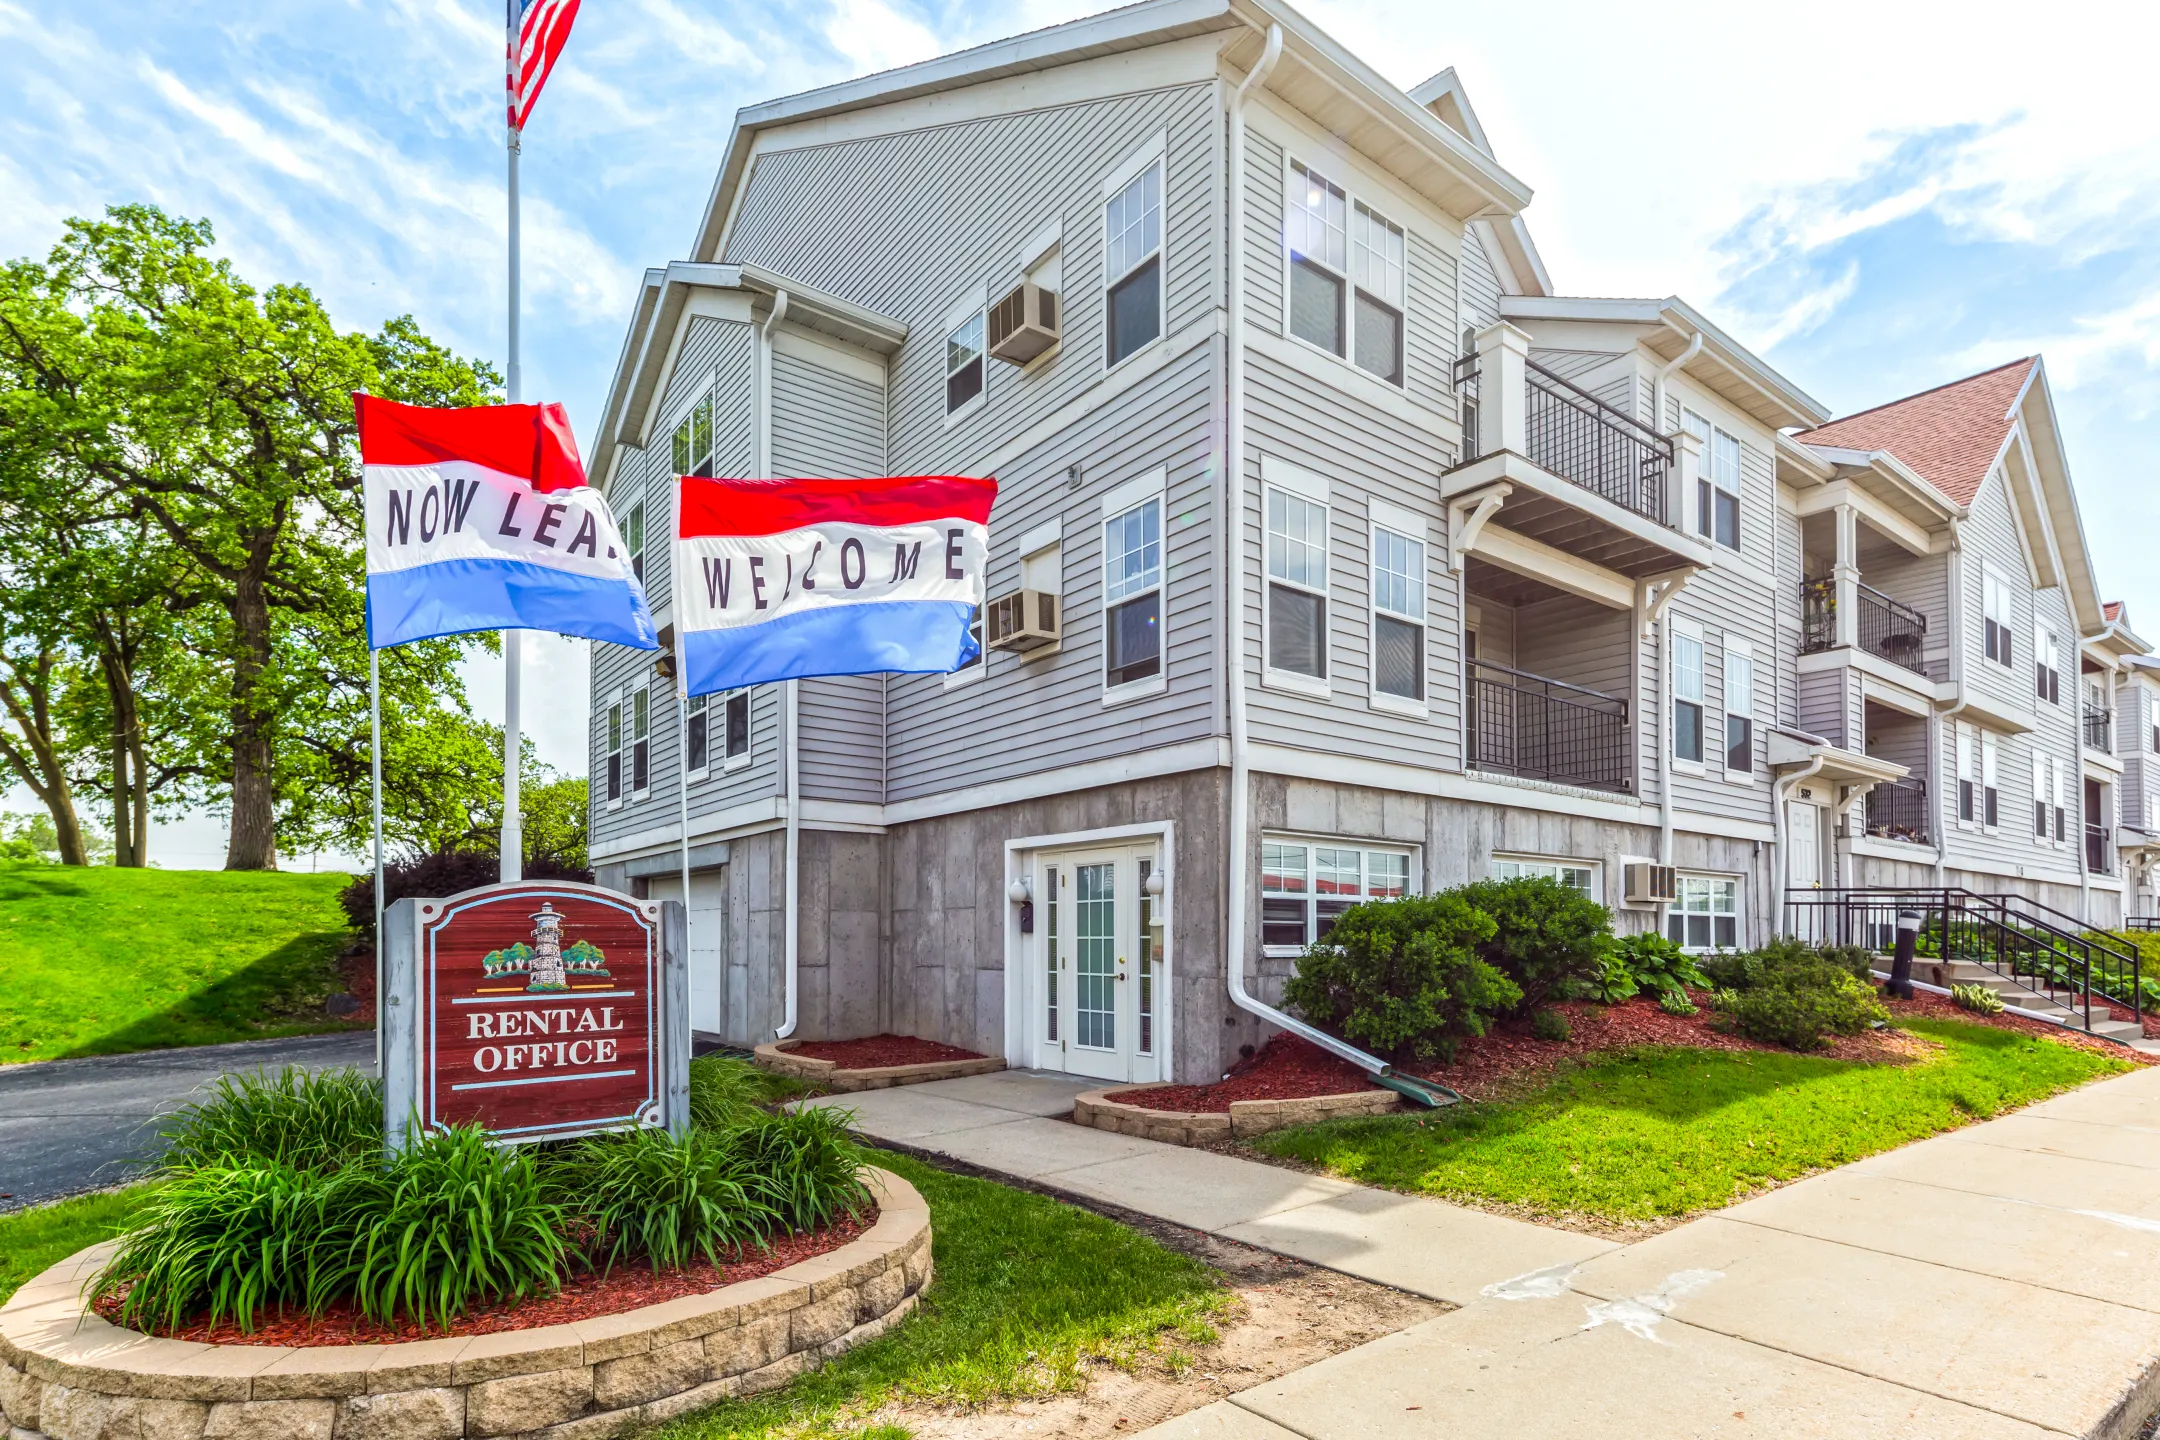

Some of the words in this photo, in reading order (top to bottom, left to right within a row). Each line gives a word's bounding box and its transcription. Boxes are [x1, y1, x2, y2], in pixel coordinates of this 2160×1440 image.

[388, 479, 480, 547] NOW
[498, 491, 618, 559] LEA
[466, 1007, 623, 1038] RENTAL
[473, 1039, 617, 1073] OFFICE
